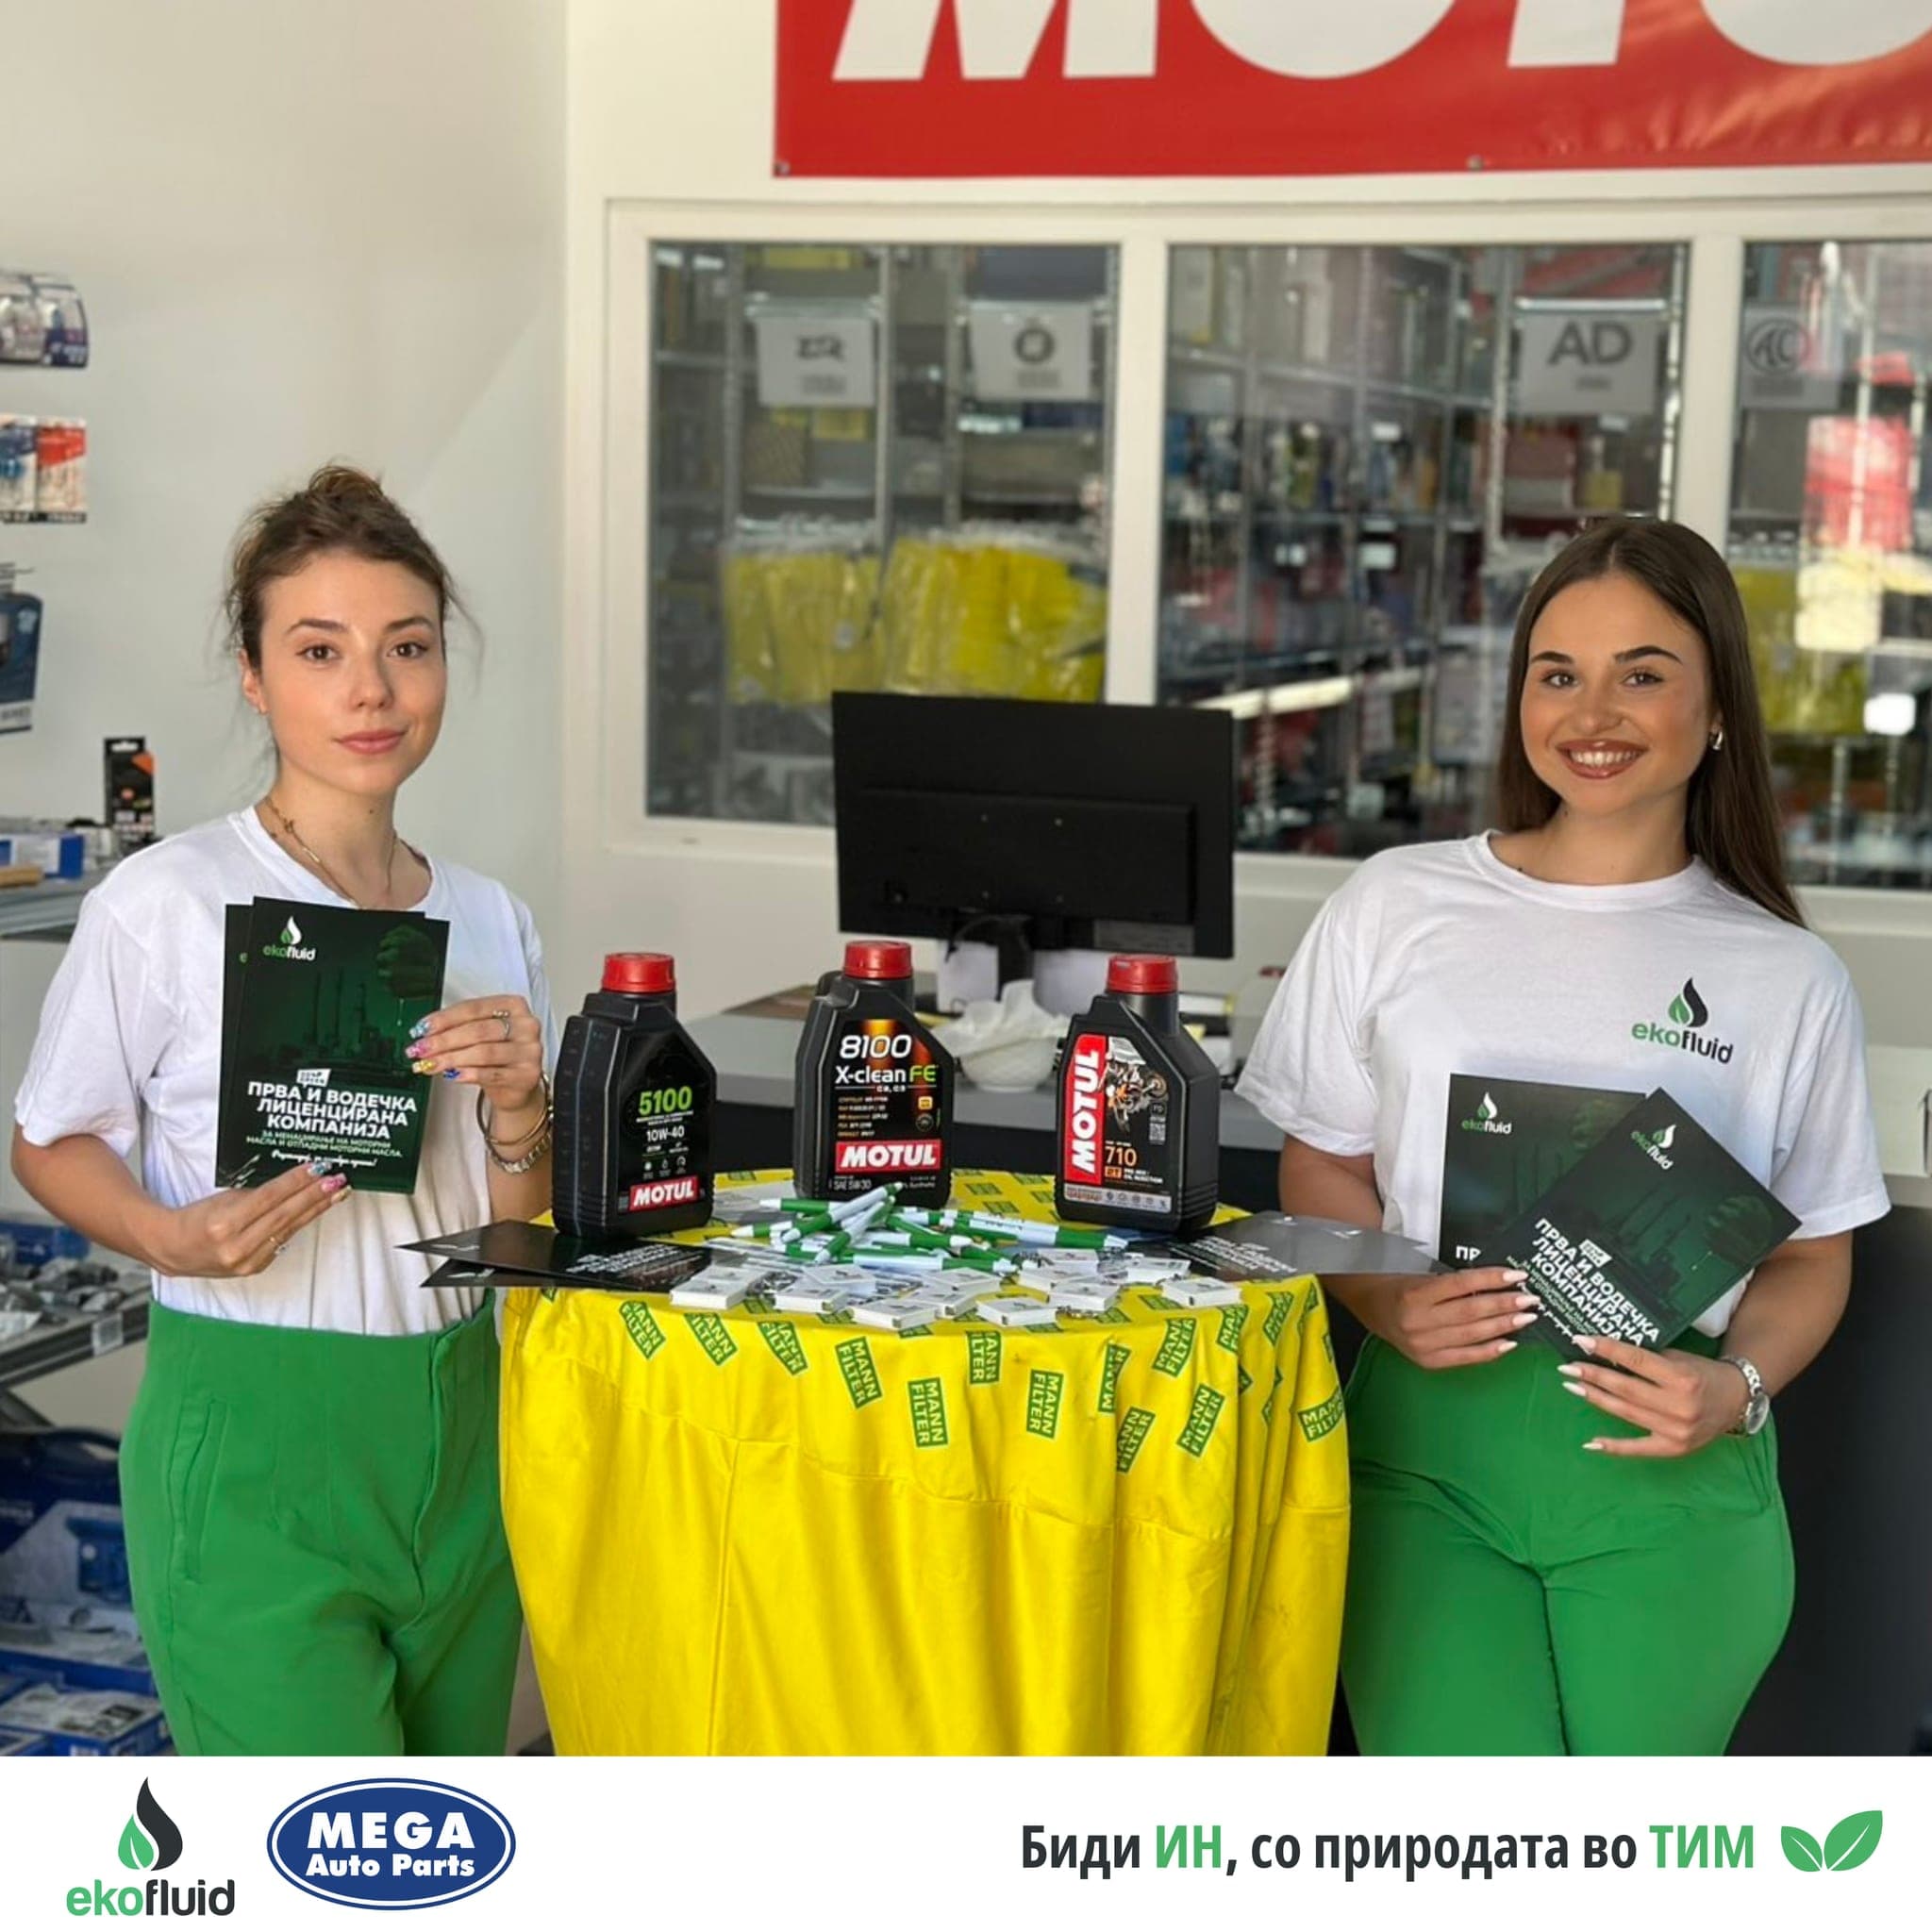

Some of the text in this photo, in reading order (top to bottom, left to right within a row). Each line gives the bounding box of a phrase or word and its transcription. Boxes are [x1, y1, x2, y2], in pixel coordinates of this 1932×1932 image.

[1548, 322, 1633, 366] AD
[263, 944, 316, 961] ekofluid
[840, 1035, 912, 1058] 8100
[1631, 1022, 1733, 1064] ekofluid
[835, 1064, 937, 1084] X-clean FE
[247, 1081, 417, 1112] ПРВА И ВОДЕЧКА
[257, 1098, 408, 1126] ЛИЦЕНЦИРАНА
[639, 1086, 693, 1116] 5100
[1072, 1050, 1100, 1174] MOTUL
[267, 1114, 391, 1140] КОМПАНИЈА
[646, 1125, 685, 1142] 10W-40
[1461, 1120, 1512, 1135] ekofluid
[841, 1144, 937, 1168] MOTUL
[1105, 1146, 1137, 1167] 710
[1630, 1130, 1674, 1170] ekofluid
[634, 1180, 694, 1207] MOTUL
[1456, 1245, 1481, 1261] ПР
[1529, 1252, 1622, 1341] КОМПАНИЈА
[1531, 1235, 1644, 1346] ЛИЦЕНЦИРАНА
[1534, 1217, 1578, 1261] ПРВА
[1574, 1257, 1593, 1274] И
[1589, 1271, 1660, 1342] ВОДЕЧКА
[622, 1304, 653, 1356] FILTER
[691, 1316, 724, 1361] ILTER
[707, 1316, 733, 1355] ANN
[1165, 1319, 1193, 1373] FILTER
[838, 1345, 866, 1404] FILTER
[852, 1341, 878, 1398] MANN
[971, 1333, 985, 1380] ILTER
[985, 1332, 998, 1380] ANN
[910, 1383, 931, 1444] FILTER
[925, 1381, 944, 1443] MANN
[1028, 1373, 1045, 1432] FILTER
[1041, 1374, 1060, 1435] MANN
[1181, 1388, 1211, 1445] MANN
[1191, 1395, 1222, 1453] FILTER
[1118, 1411, 1141, 1451] ANN
[1120, 1414, 1152, 1469] FILTER
